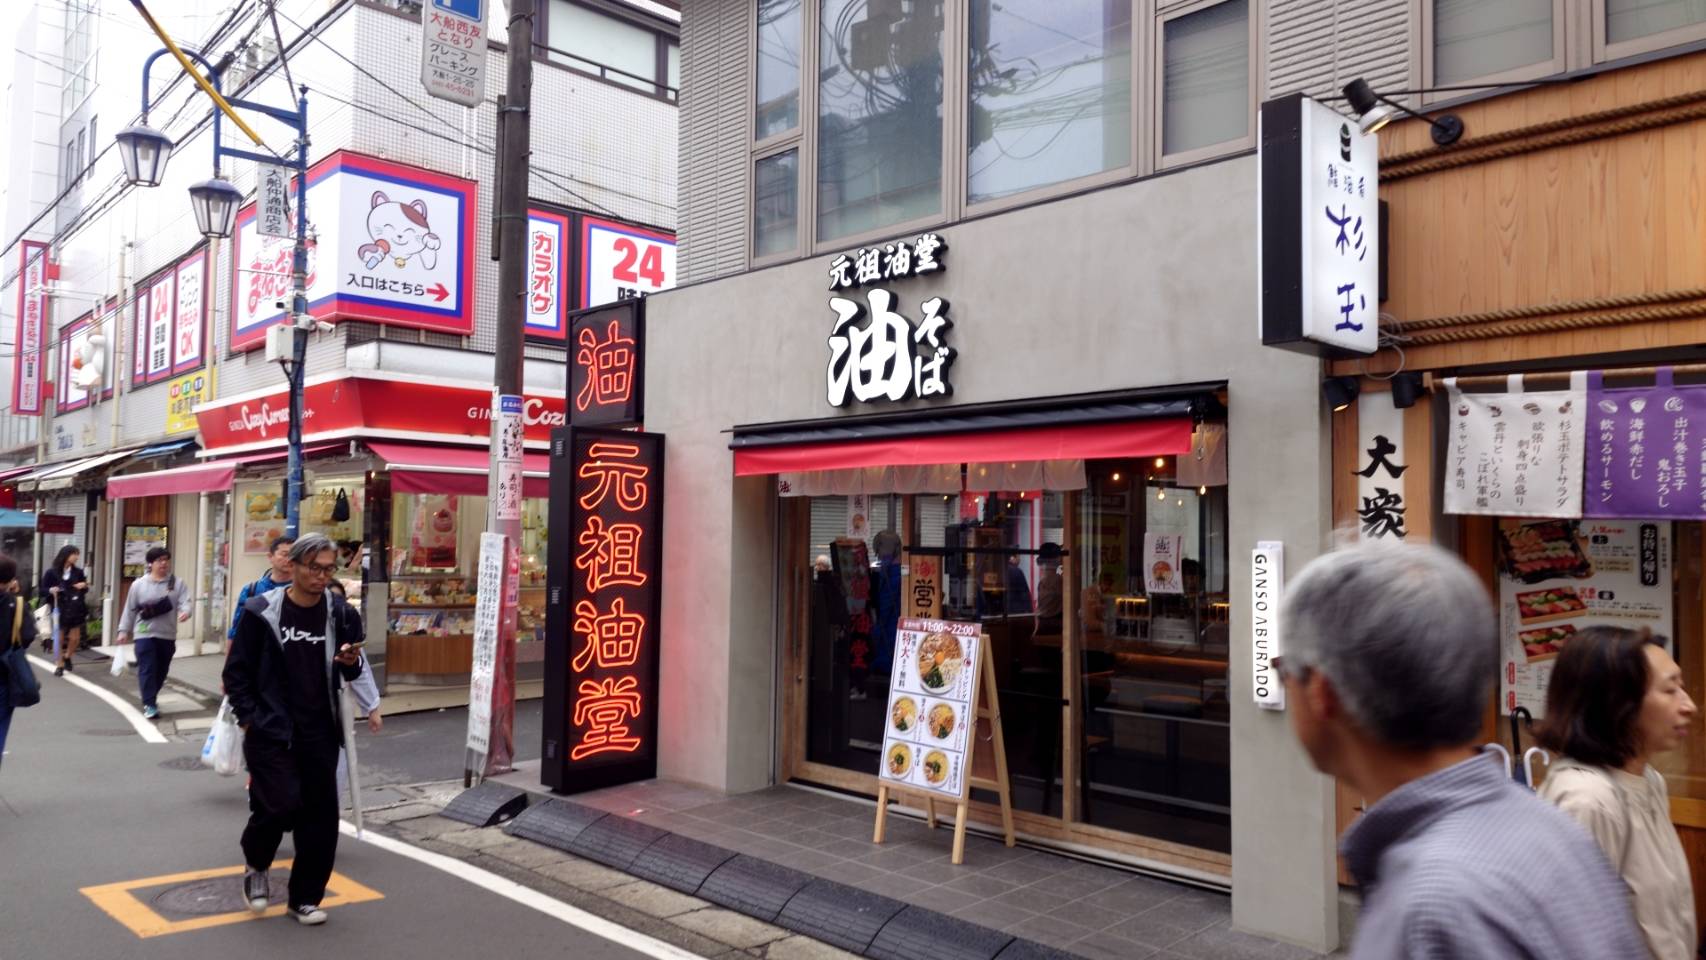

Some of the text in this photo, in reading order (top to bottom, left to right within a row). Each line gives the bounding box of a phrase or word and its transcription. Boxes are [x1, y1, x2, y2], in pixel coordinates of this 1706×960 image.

[430, 11, 481, 38] 大船西友
[430, 43, 469, 62] グレース
[438, 29, 473, 48] となり
[430, 54, 478, 76] パーキング
[347, 272, 425, 296] 入口はこちら
[533, 233, 554, 313] カラオケ
[613, 237, 665, 288] 24
[829, 233, 942, 291] 元祖油堂
[1325, 203, 1367, 332] 杉玉
[155, 283, 168, 322] 24
[576, 319, 635, 412] 油
[1456, 421, 1468, 490] キャビア寿司
[1556, 420, 1571, 508] 杉玉ポテトサラダ
[1600, 418, 1615, 502] 飲めるサーモン
[1629, 418, 1645, 480] 海鮮赤だし
[1672, 417, 1688, 491] 出汁巻き玉子
[1656, 458, 1672, 508] 鬼おろし
[1643, 528, 1657, 583] お持ち帰り
[571, 442, 650, 762] 元祖油堂
